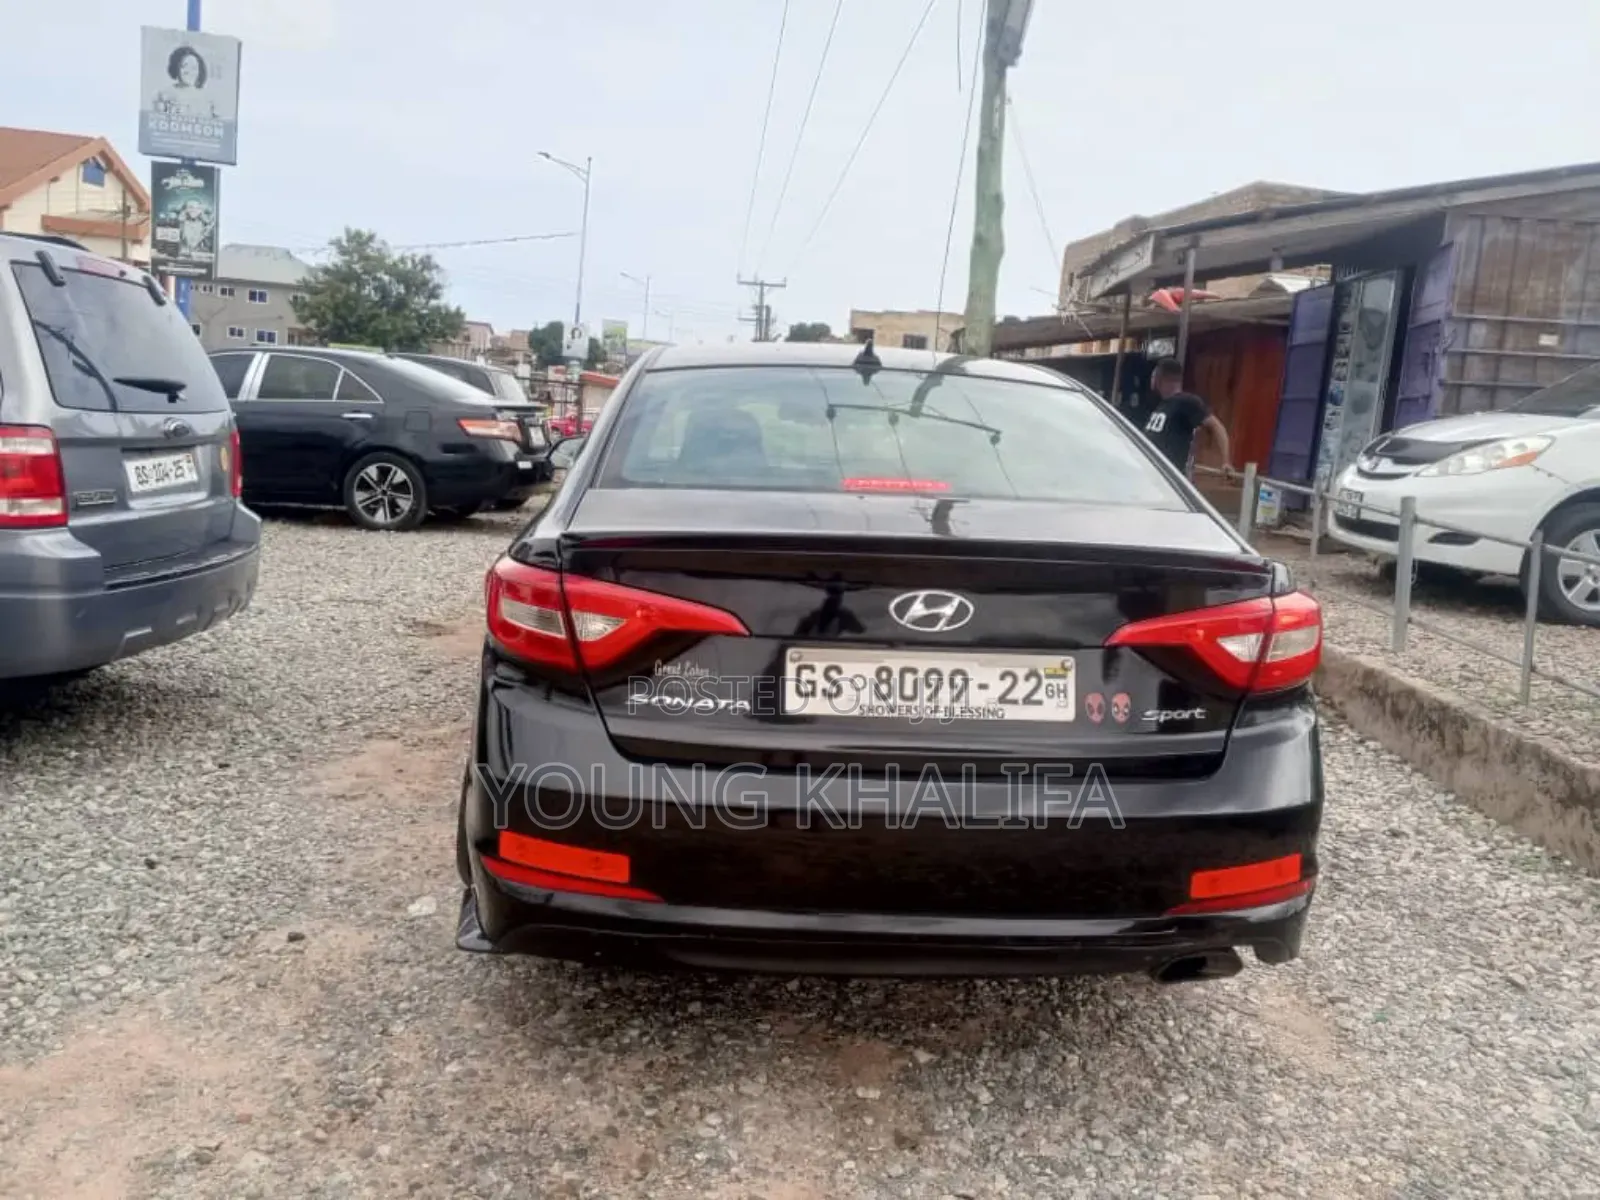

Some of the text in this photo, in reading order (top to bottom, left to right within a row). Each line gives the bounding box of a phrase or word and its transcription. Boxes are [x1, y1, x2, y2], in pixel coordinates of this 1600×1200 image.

[795, 663, 1044, 706] GS 8099-22
[626, 692, 752, 712] SONATA
